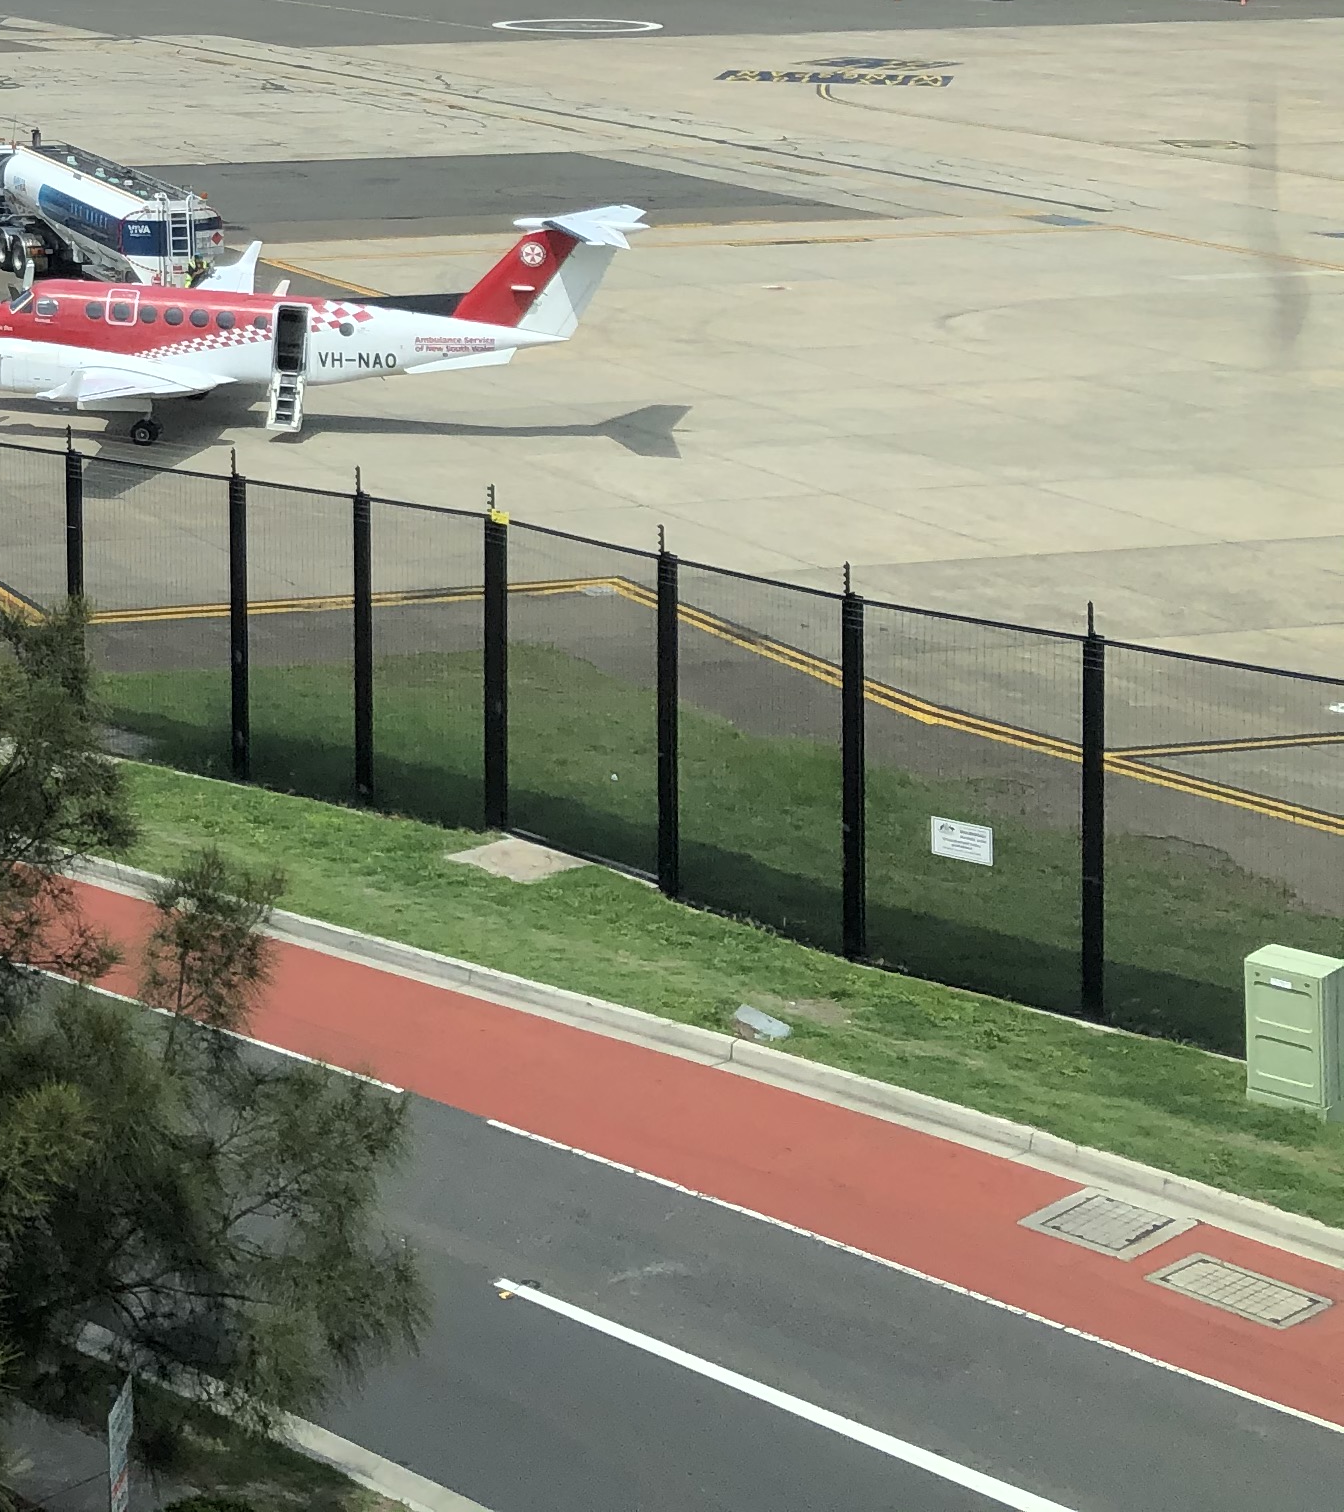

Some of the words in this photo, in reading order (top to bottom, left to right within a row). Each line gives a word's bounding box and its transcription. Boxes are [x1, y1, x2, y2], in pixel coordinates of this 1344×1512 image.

[128, 224, 151, 234] VIVA
[415, 336, 462, 344] Ambulance
[464, 336, 495, 344] Service
